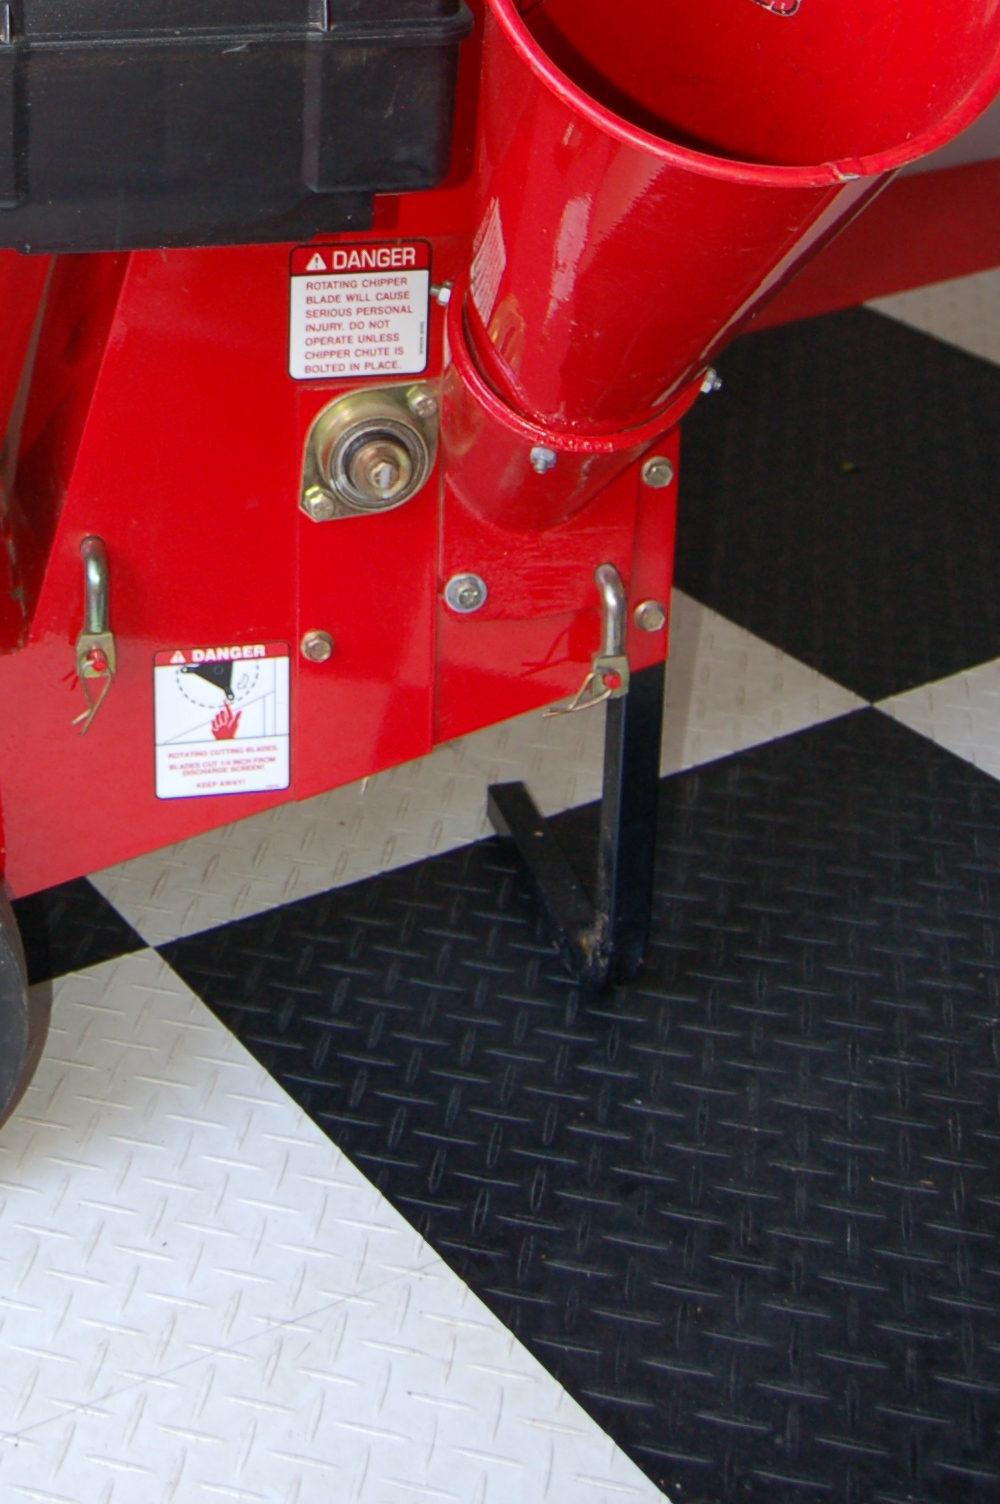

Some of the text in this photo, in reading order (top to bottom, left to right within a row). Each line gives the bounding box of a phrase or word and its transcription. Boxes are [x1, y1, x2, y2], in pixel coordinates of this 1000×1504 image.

[332, 247, 416, 270] DANGER
[305, 277, 408, 291] ROTATING CHIPPER
[305, 291, 411, 305] BLADE WILL CAUSE
[305, 304, 413, 319] SERIOUS PERSONAL
[349, 320, 365, 330] DO
[368, 319, 391, 329] NOT
[304, 332, 400, 346] OPERATE UNLESS
[304, 346, 405, 360] CHIPPER CHUTE IS
[304, 363, 346, 374] BOLTED
[349, 362, 360, 371] IN
[191, 644, 266, 662] DANGER
